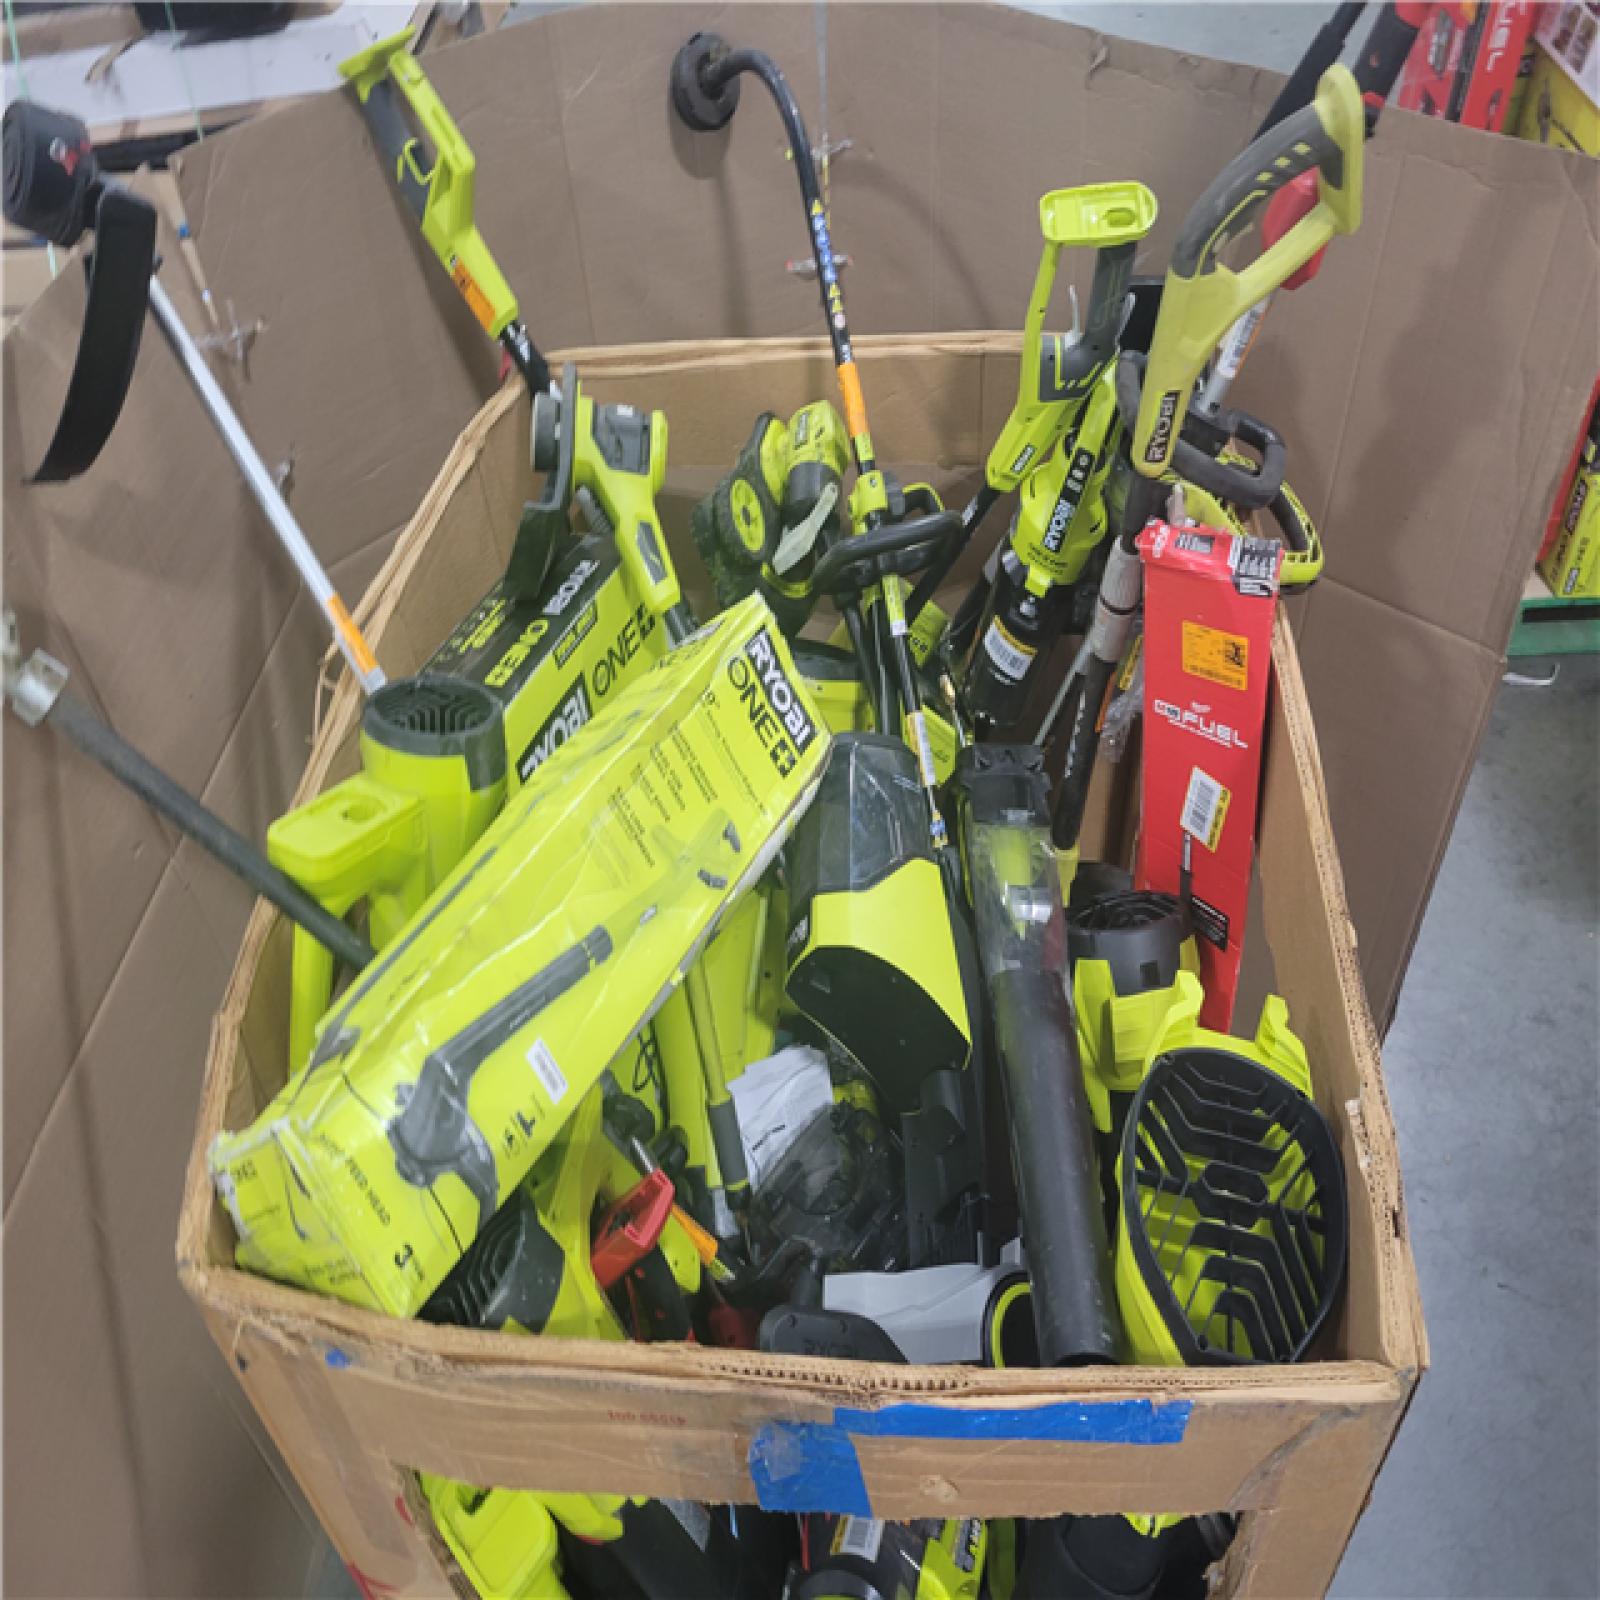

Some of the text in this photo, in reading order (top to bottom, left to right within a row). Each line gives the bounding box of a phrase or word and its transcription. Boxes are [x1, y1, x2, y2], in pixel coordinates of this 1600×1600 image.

[1147, 397, 1175, 461] RYOBI
[1045, 500, 1075, 551] RYOBI
[749, 630, 811, 746] RYOBI
[1182, 709, 1249, 750] FUEL
[394, 1244, 415, 1268] 3
